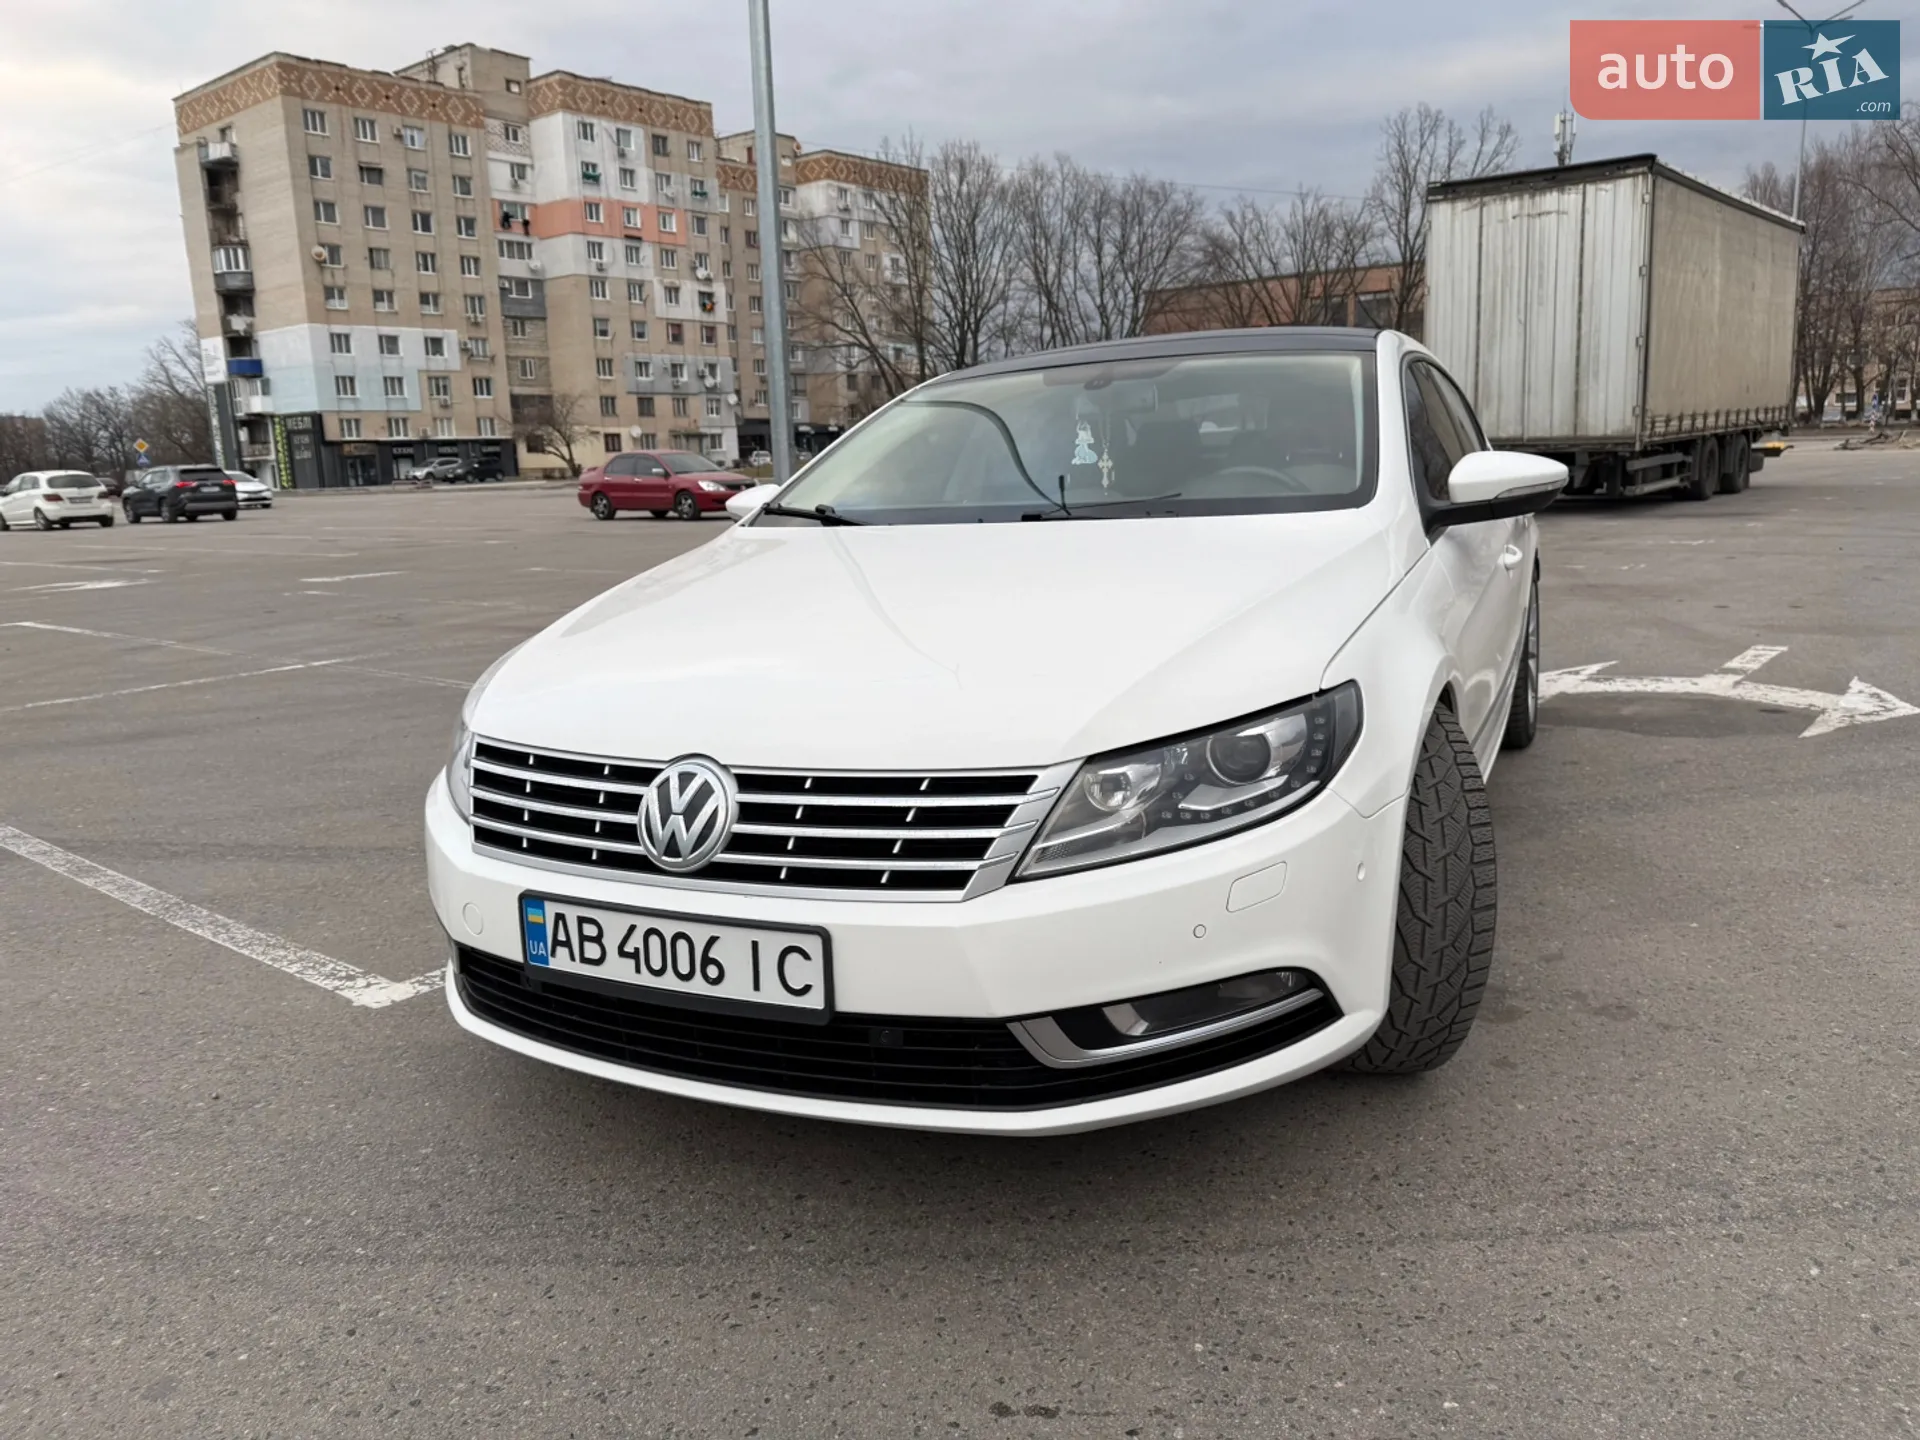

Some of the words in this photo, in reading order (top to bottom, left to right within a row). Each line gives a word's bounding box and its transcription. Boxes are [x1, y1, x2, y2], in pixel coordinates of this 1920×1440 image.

[642, 768, 722, 862] VW
[529, 939, 547, 957] UA
[550, 912, 607, 966] AB
[617, 924, 725, 986] 4006
[751, 940, 813, 997] IC
